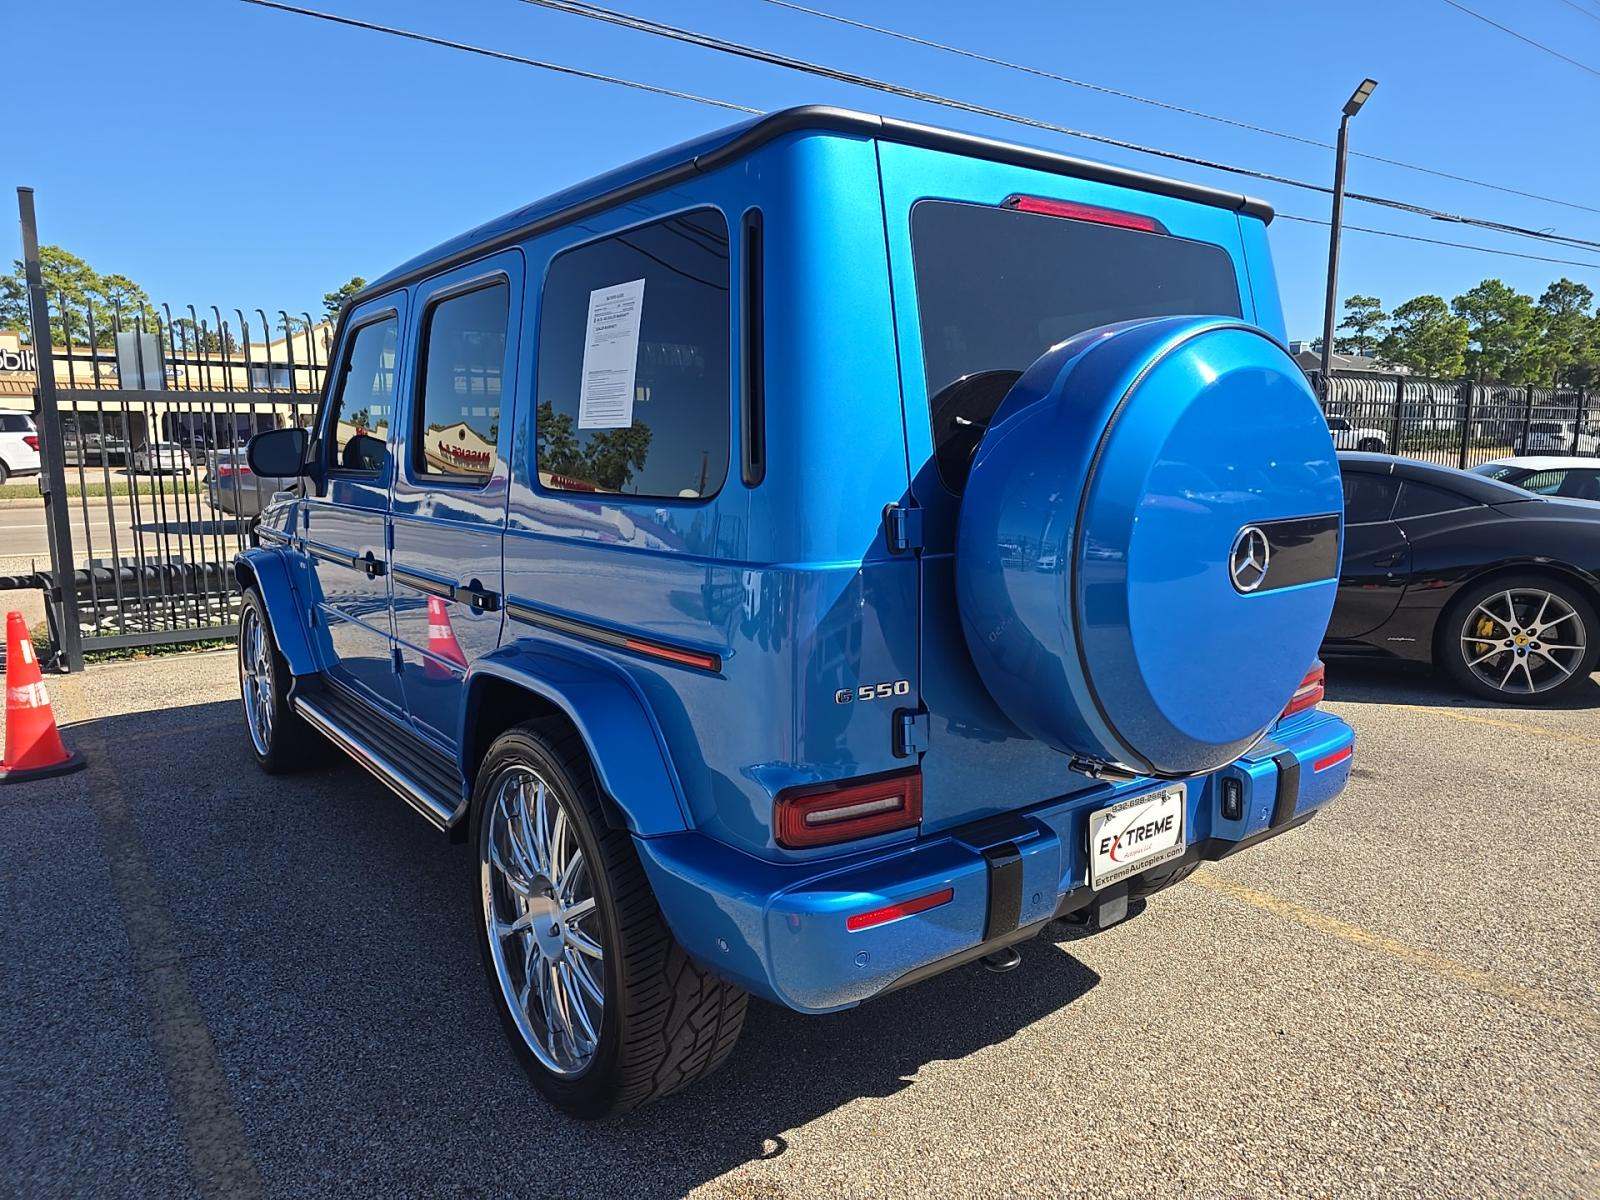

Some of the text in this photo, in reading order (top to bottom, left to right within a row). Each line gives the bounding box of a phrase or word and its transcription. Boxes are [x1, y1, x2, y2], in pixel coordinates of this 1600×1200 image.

[836, 680, 910, 704] G 550
[1099, 815, 1174, 855] EXTREME
[1095, 847, 1183, 887] ExtremeAutoplex.com
